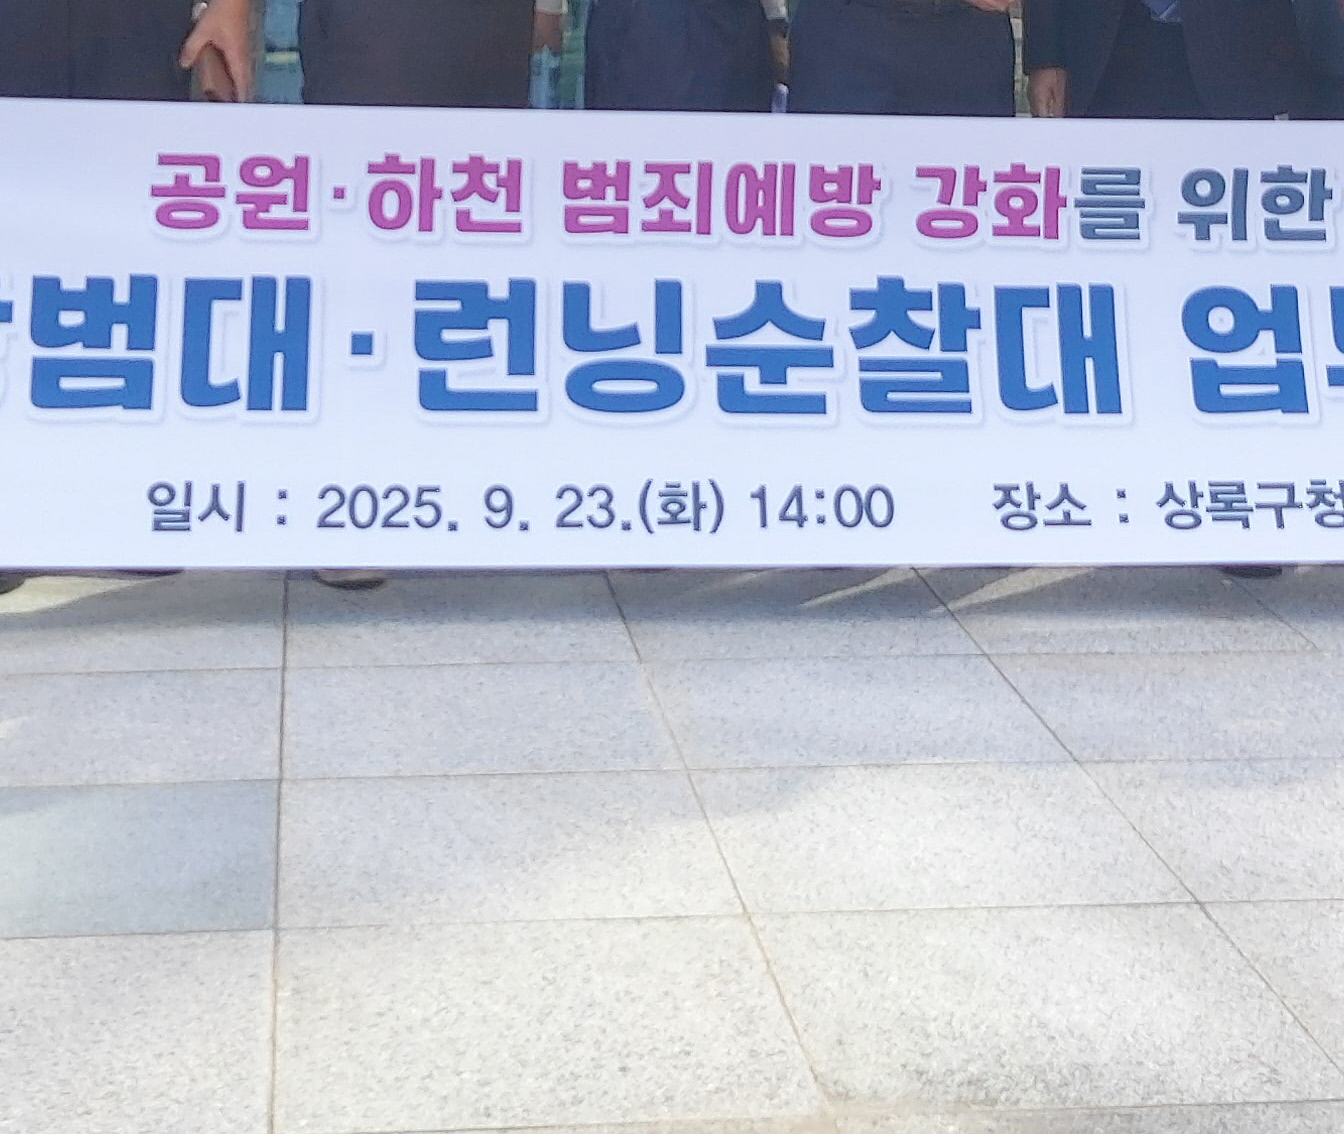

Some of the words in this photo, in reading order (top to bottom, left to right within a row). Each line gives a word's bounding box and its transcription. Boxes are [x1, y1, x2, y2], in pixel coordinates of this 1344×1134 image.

[562, 160, 882, 238] 범죄예방
[915, 163, 1146, 241] 강화를
[1177, 165, 1333, 243] 위한
[147, 480, 245, 533] 일시
[316, 484, 458, 532] 2025.
[483, 484, 529, 532] 9.
[555, 478, 725, 535] 23.(화)
[750, 484, 895, 530] 14:00
[992, 481, 1093, 532] 장소
